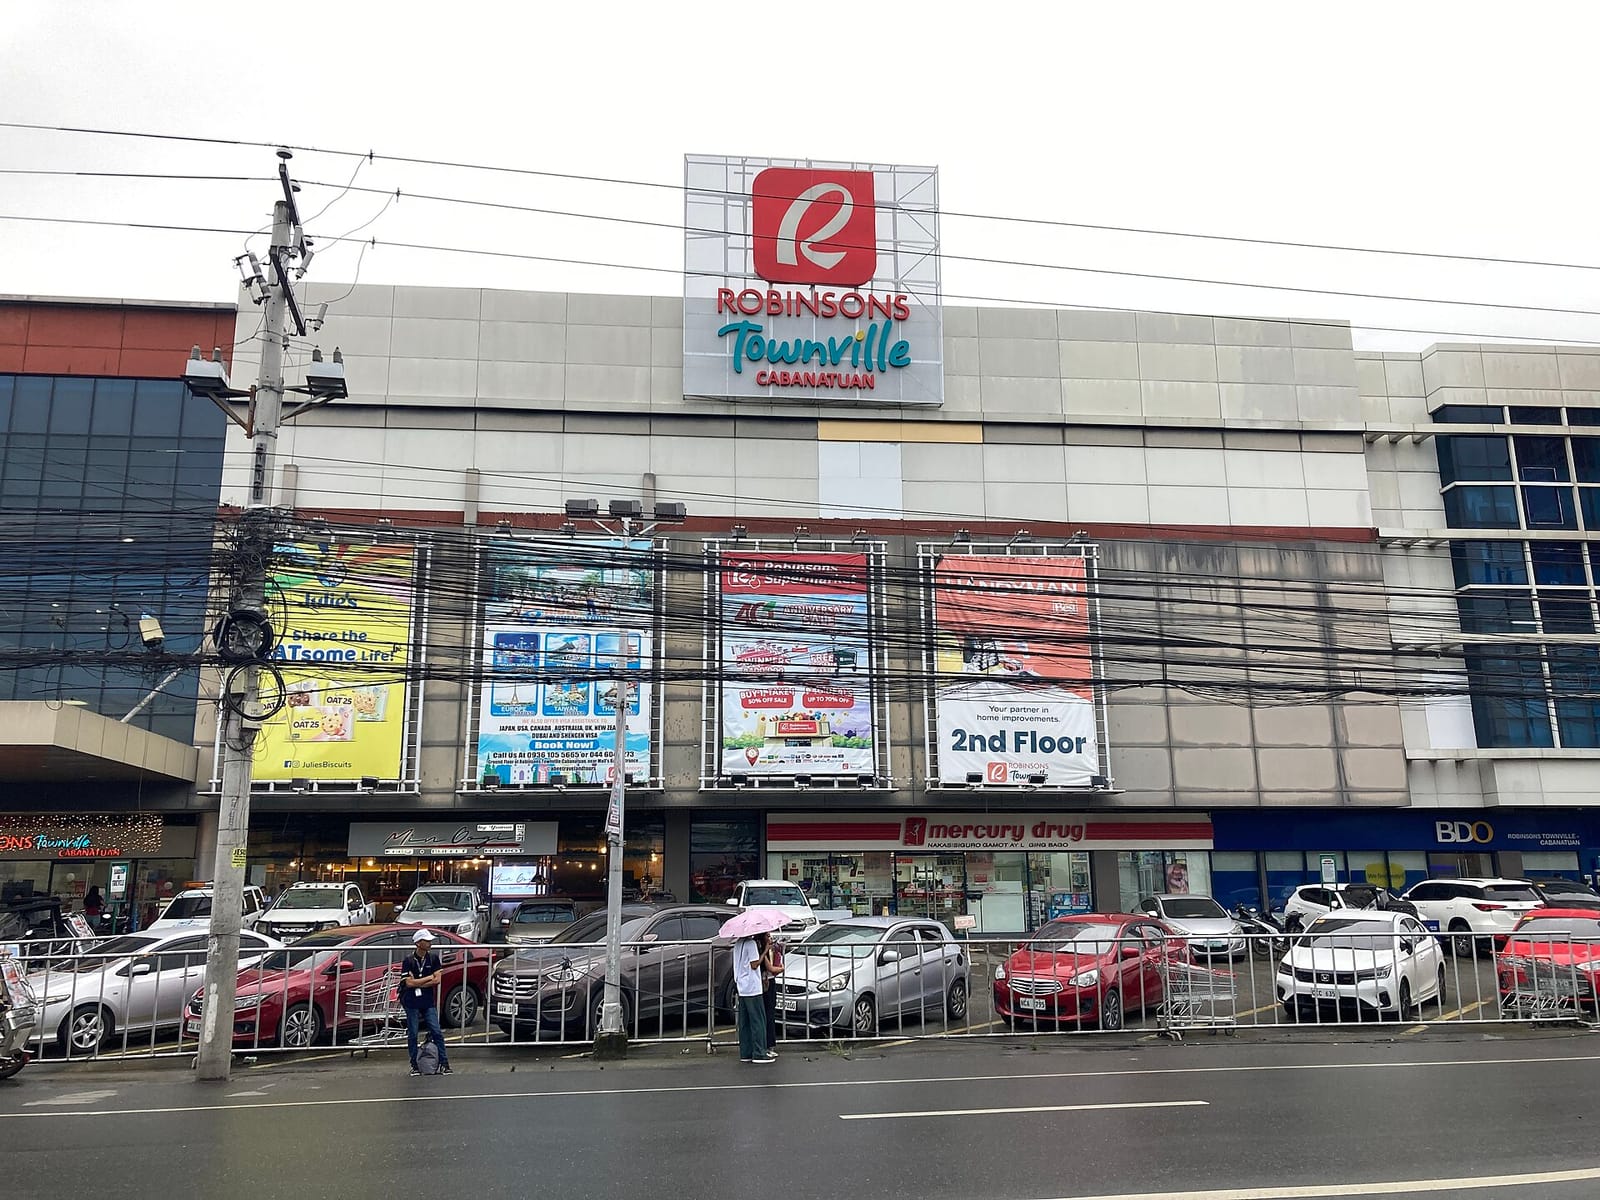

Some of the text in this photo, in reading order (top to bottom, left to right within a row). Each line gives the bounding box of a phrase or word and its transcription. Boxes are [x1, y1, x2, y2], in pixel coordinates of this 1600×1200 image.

[717, 287, 910, 320] ROBINSONS
[718, 319, 912, 373] Townville
[756, 370, 875, 389] CABANATUAN
[293, 629, 367, 641] Share the
[361, 649, 395, 662] Life!
[326, 696, 352, 705] OAT 25
[988, 705, 1007, 713] Your
[1009, 706, 1039, 714] partner
[976, 714, 1061, 723] home improvements.
[293, 721, 320, 729] OAT 25
[534, 741, 594, 749] Book Now!
[951, 728, 1087, 754] 2nd Floor
[302, 761, 352, 769] JuliesBiscuits
[1008, 762, 1049, 770] ROBINSONS
[928, 821, 1083, 842] mercury drug
[1435, 821, 1494, 844] BDO
[34, 833, 91, 850] Townville
[58, 848, 121, 858] CABANATUAN
